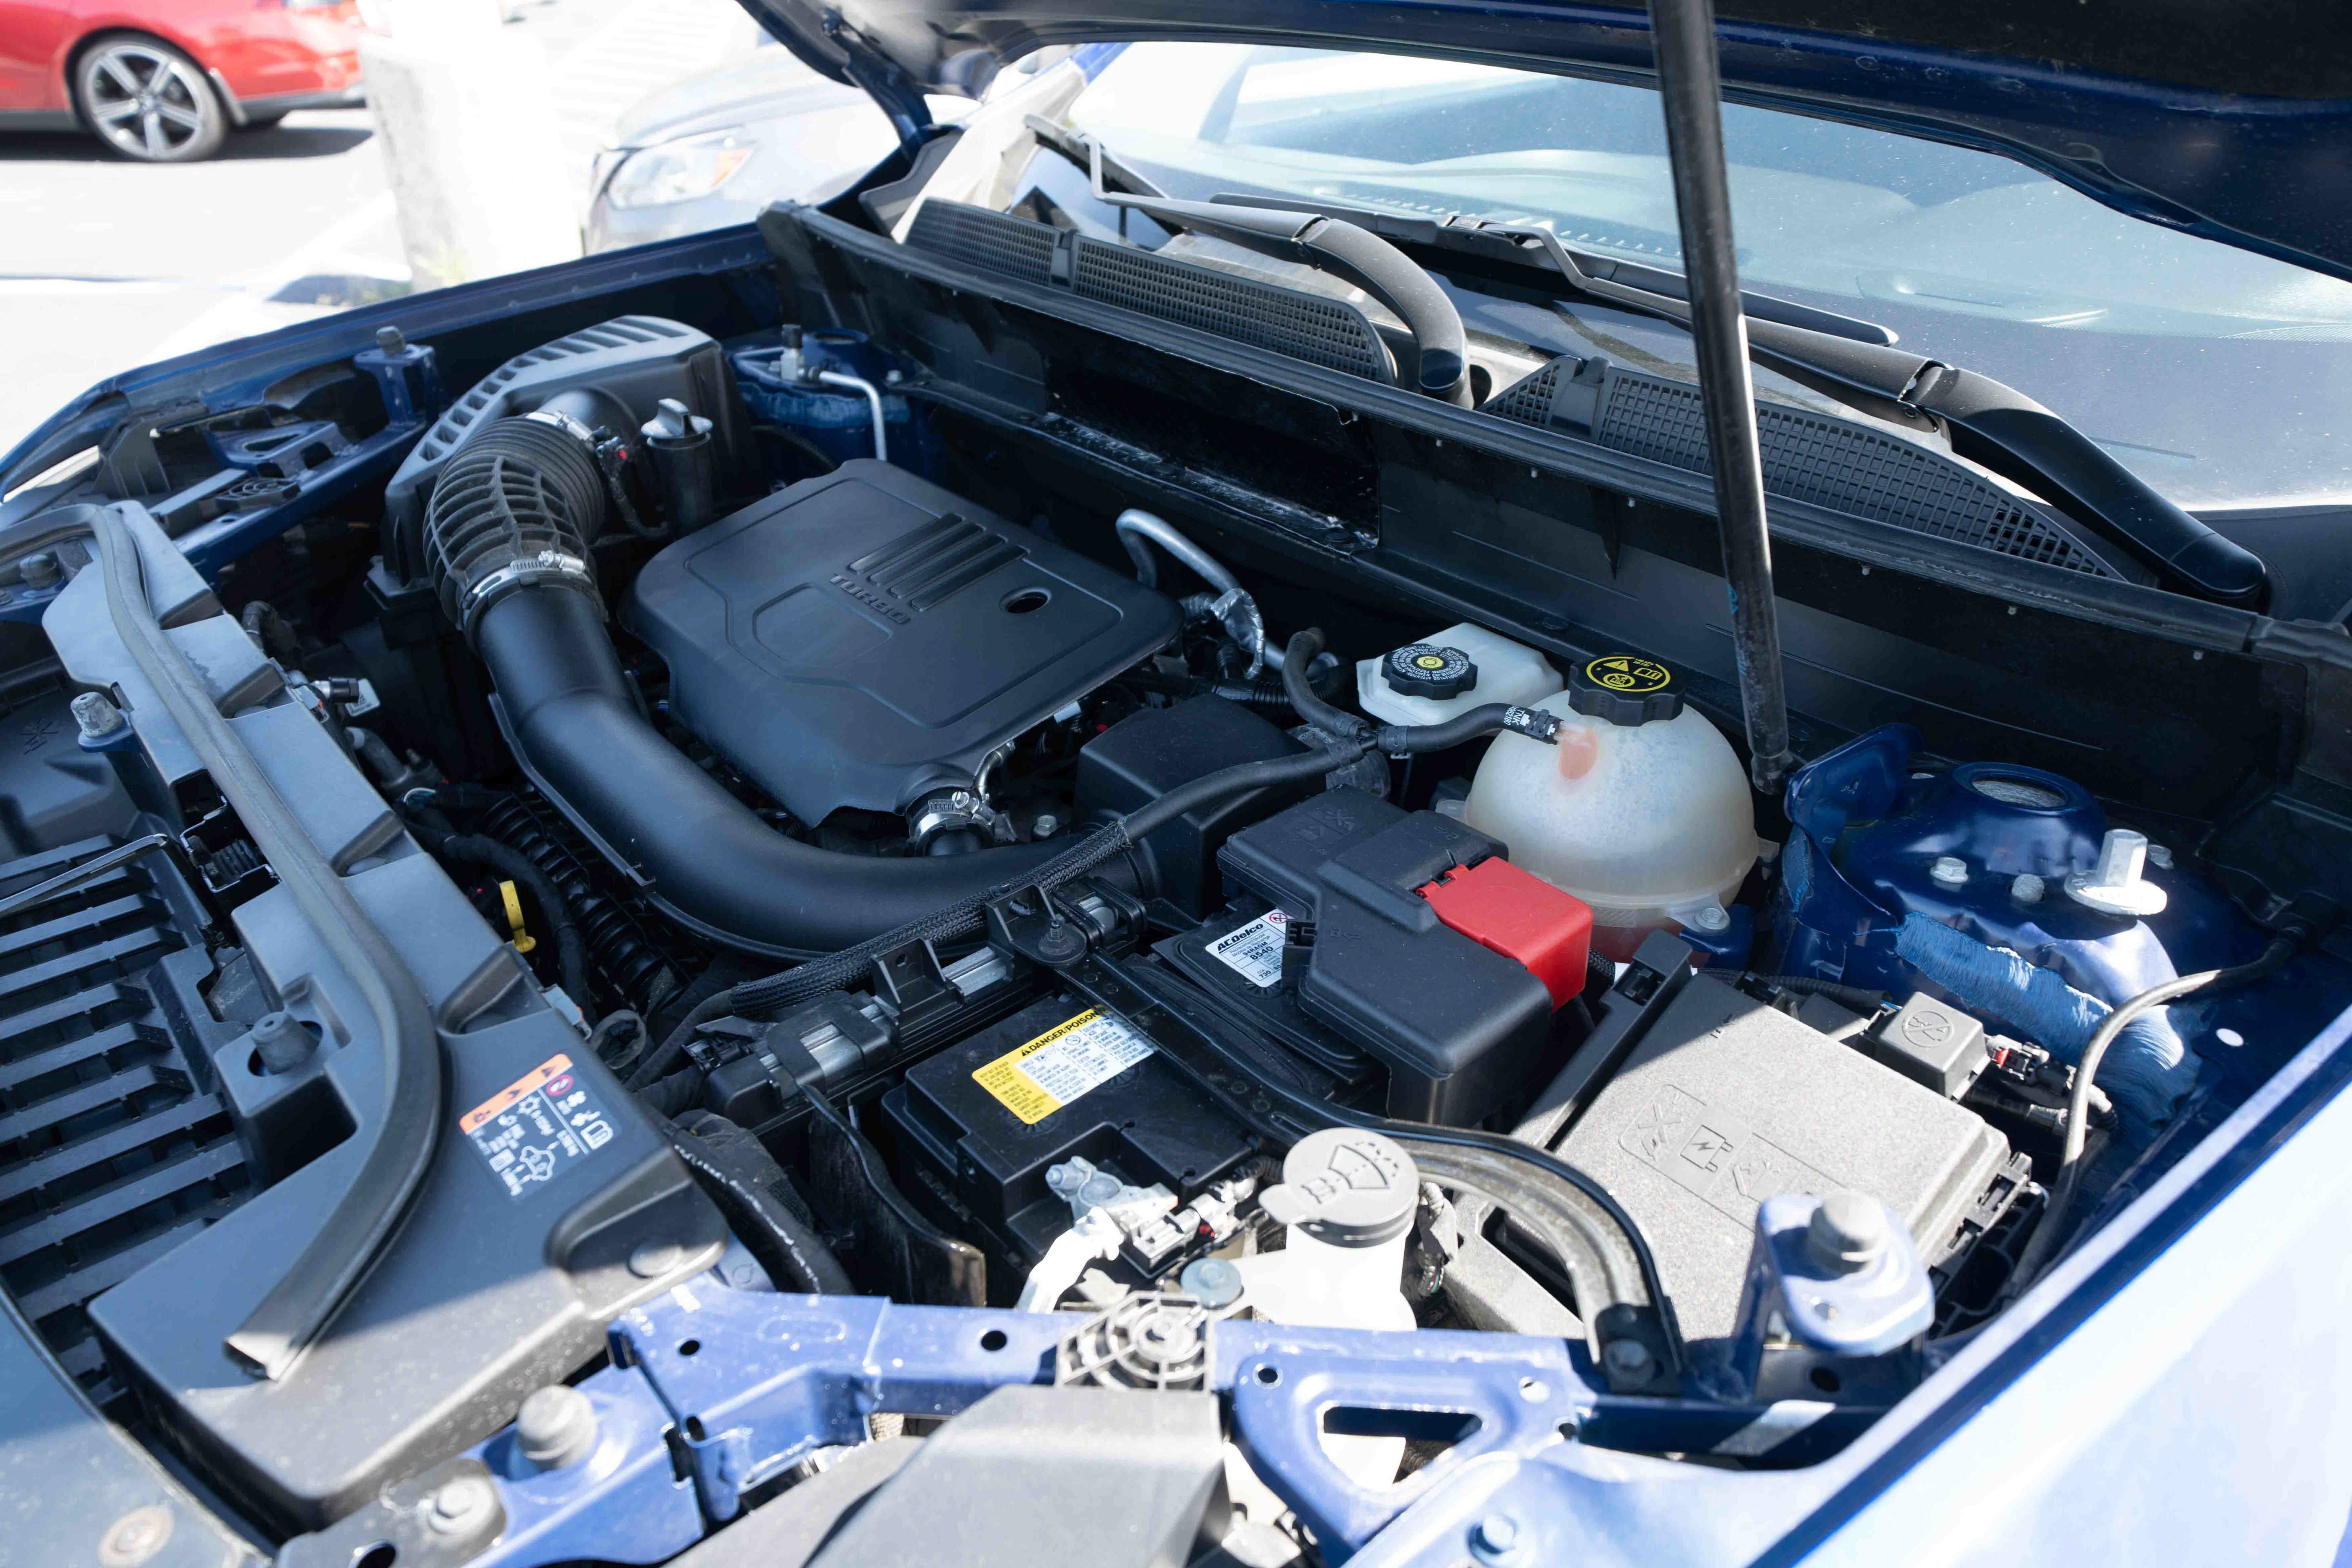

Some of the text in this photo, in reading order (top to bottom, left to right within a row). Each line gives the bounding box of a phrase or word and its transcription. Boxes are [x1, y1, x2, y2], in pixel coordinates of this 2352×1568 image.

[830, 573, 910, 624] TURBO
[1512, 710, 1525, 725] TNK
[1218, 924, 1263, 951] ACDelco
[1243, 942, 1268, 956] 94RAGM
[1250, 946, 1274, 960] 8540
